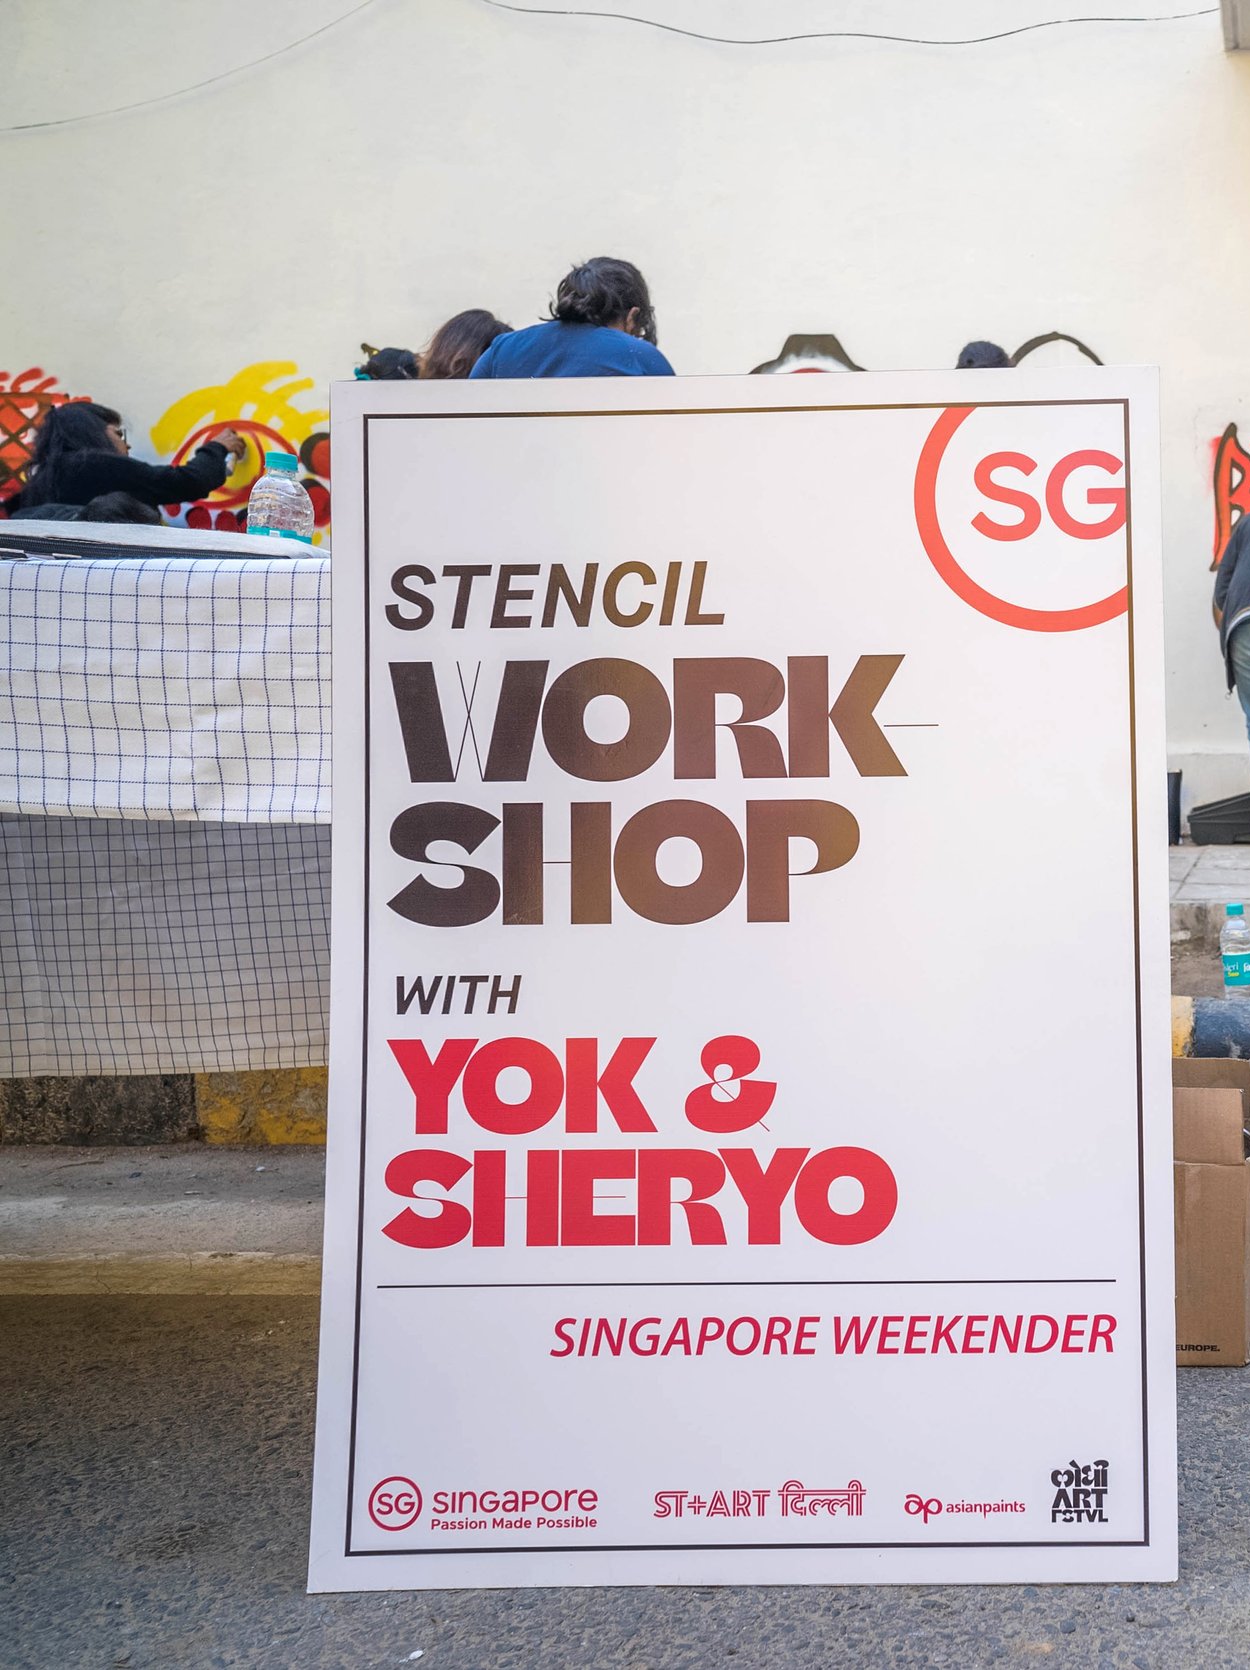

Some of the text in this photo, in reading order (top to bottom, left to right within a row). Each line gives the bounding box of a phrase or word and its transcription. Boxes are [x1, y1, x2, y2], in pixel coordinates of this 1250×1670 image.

[971, 450, 1126, 542] SG
[385, 561, 725, 631] STENCIL
[388, 654, 939, 783] WORK-
[386, 799, 860, 928] SHOP
[396, 975, 522, 1015] WITH
[386, 1035, 777, 1135] YOK &
[381, 1146, 898, 1249] SHERYO
[550, 1314, 1118, 1357] SINGAPORE WEEKENDER
[376, 1491, 416, 1516] SG
[653, 1490, 771, 1518] ST+ART
[946, 1500, 1026, 1519] asianpaints
[1052, 1488, 1108, 1509] ART
[431, 1516, 597, 1530] Passion Made Possible
